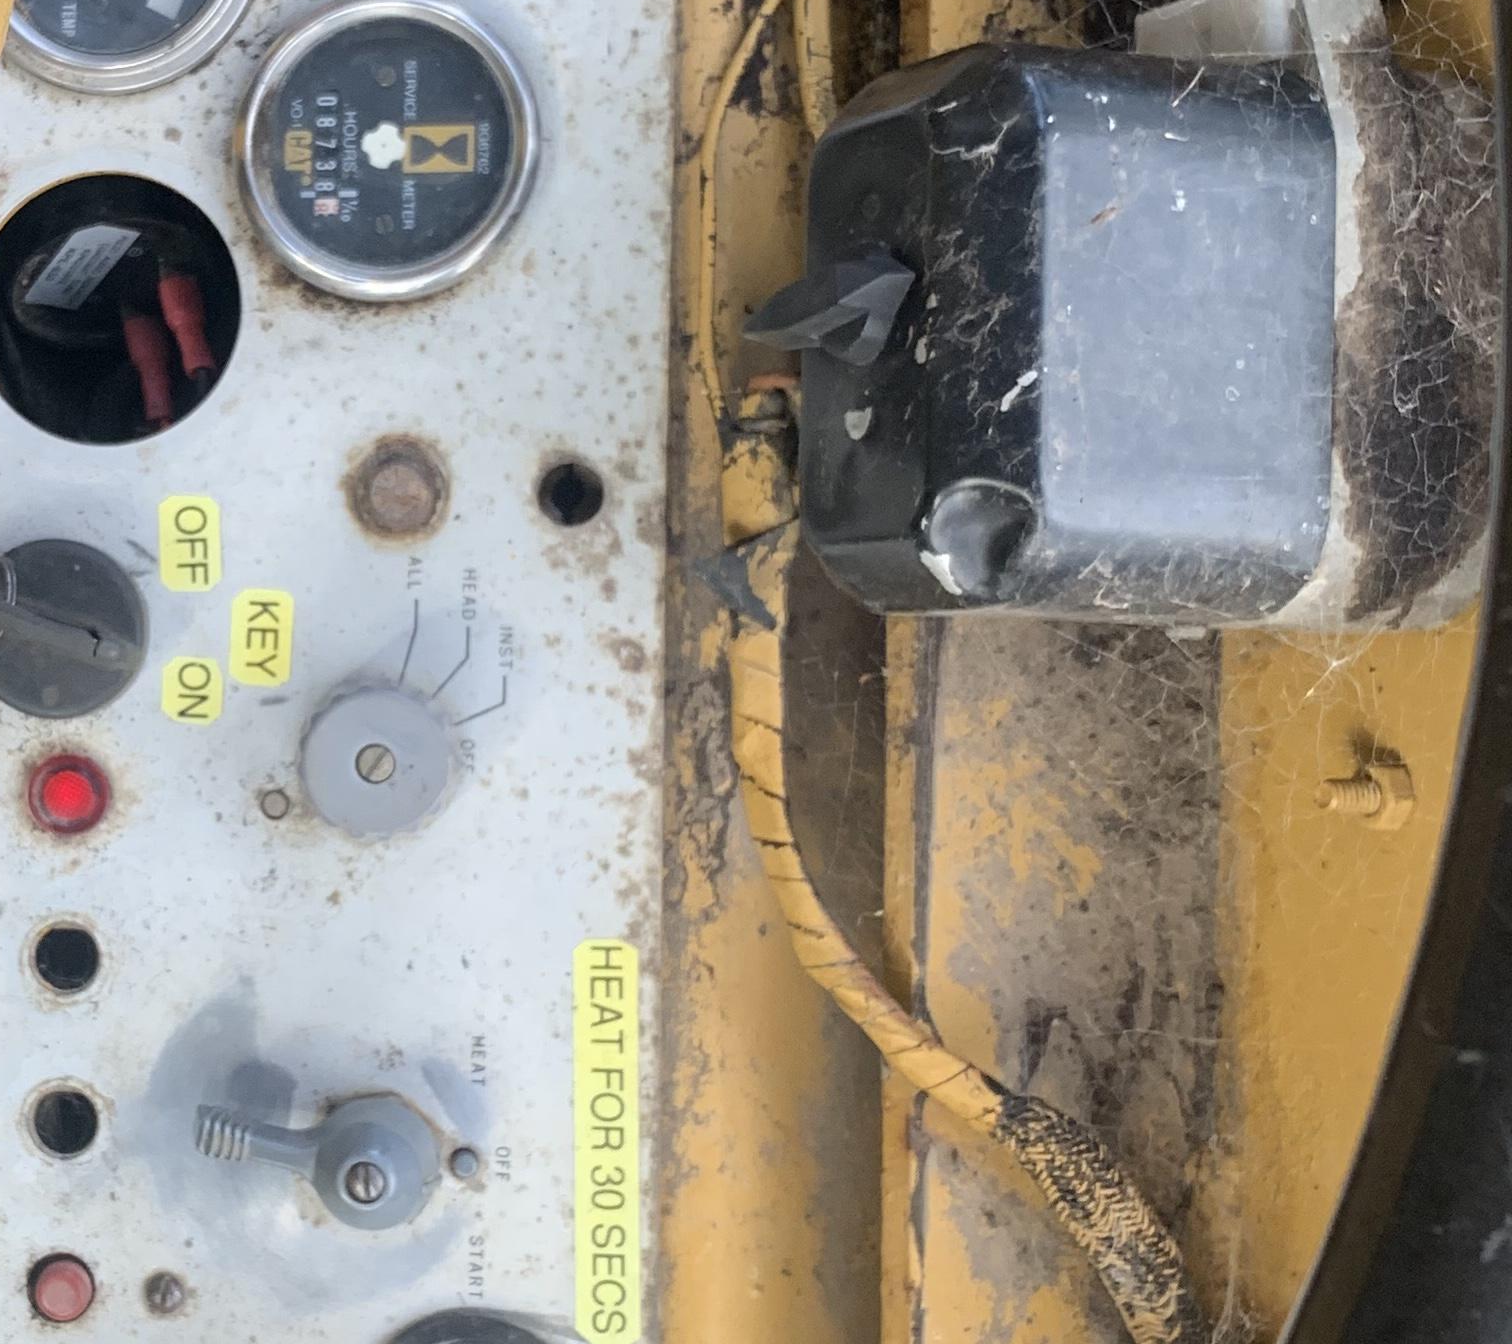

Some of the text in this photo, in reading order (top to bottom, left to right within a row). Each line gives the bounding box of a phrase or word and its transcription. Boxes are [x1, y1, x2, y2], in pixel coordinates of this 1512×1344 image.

[62, 4, 77, 38] TEMP
[283, 130, 313, 175] CAT
[342, 111, 358, 173] HOURS
[402, 60, 417, 230] SERVICE METER
[173, 504, 210, 586] OFF
[407, 556, 423, 590] ALL
[462, 567, 477, 622] HEAD
[244, 599, 281, 679] KEY
[499, 625, 514, 671] INST
[176, 661, 212, 721] ON
[461, 739, 475, 775] OFF
[470, 1034, 487, 1088] HEAT
[494, 1145, 511, 1184] OFF
[589, 944, 627, 1336] HEAT FOR 30 SECS
[467, 1234, 485, 1301] START
